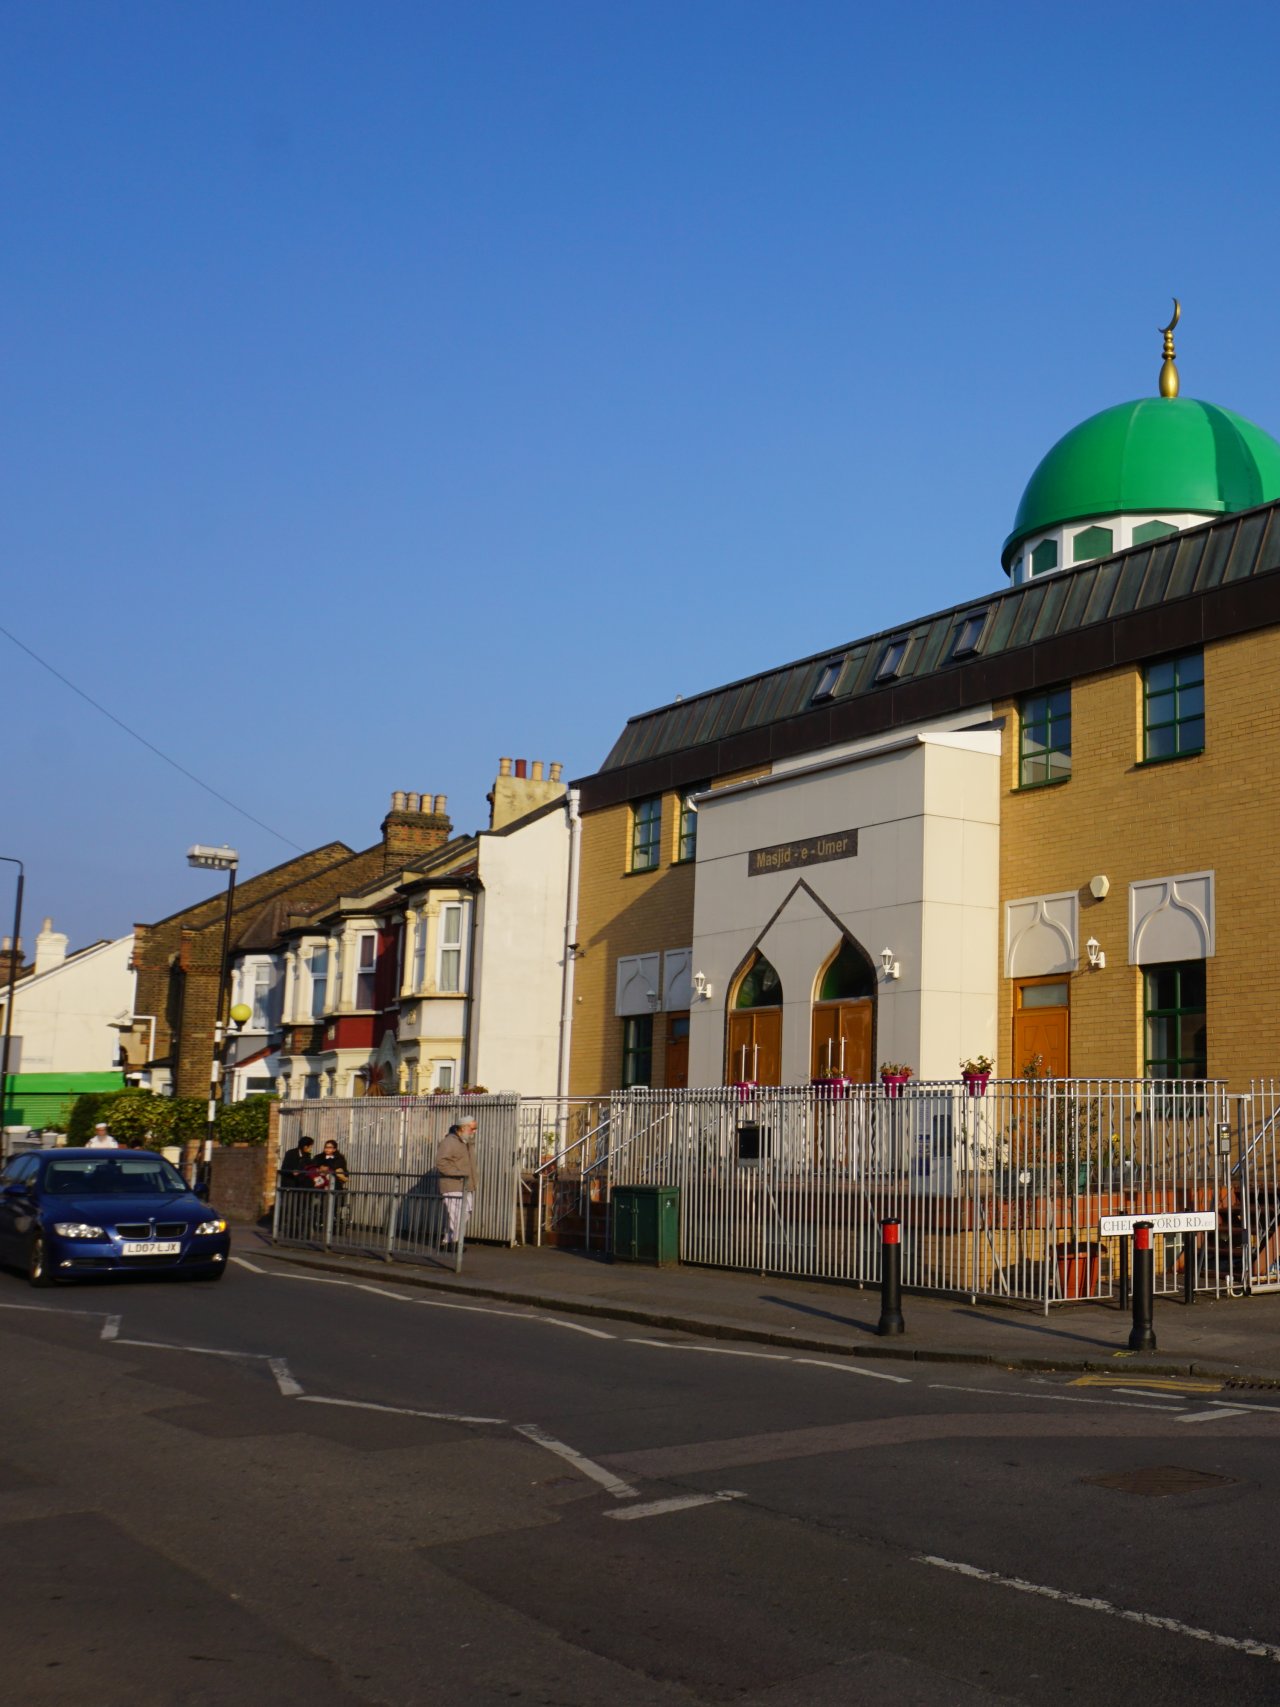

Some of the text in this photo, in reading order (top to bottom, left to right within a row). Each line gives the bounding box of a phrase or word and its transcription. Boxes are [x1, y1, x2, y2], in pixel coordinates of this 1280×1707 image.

[757, 848, 791, 868] Masjid
[801, 847, 808, 859] e
[817, 838, 848, 856] Umer
[1103, 1217, 1181, 1232] CHELFORD
